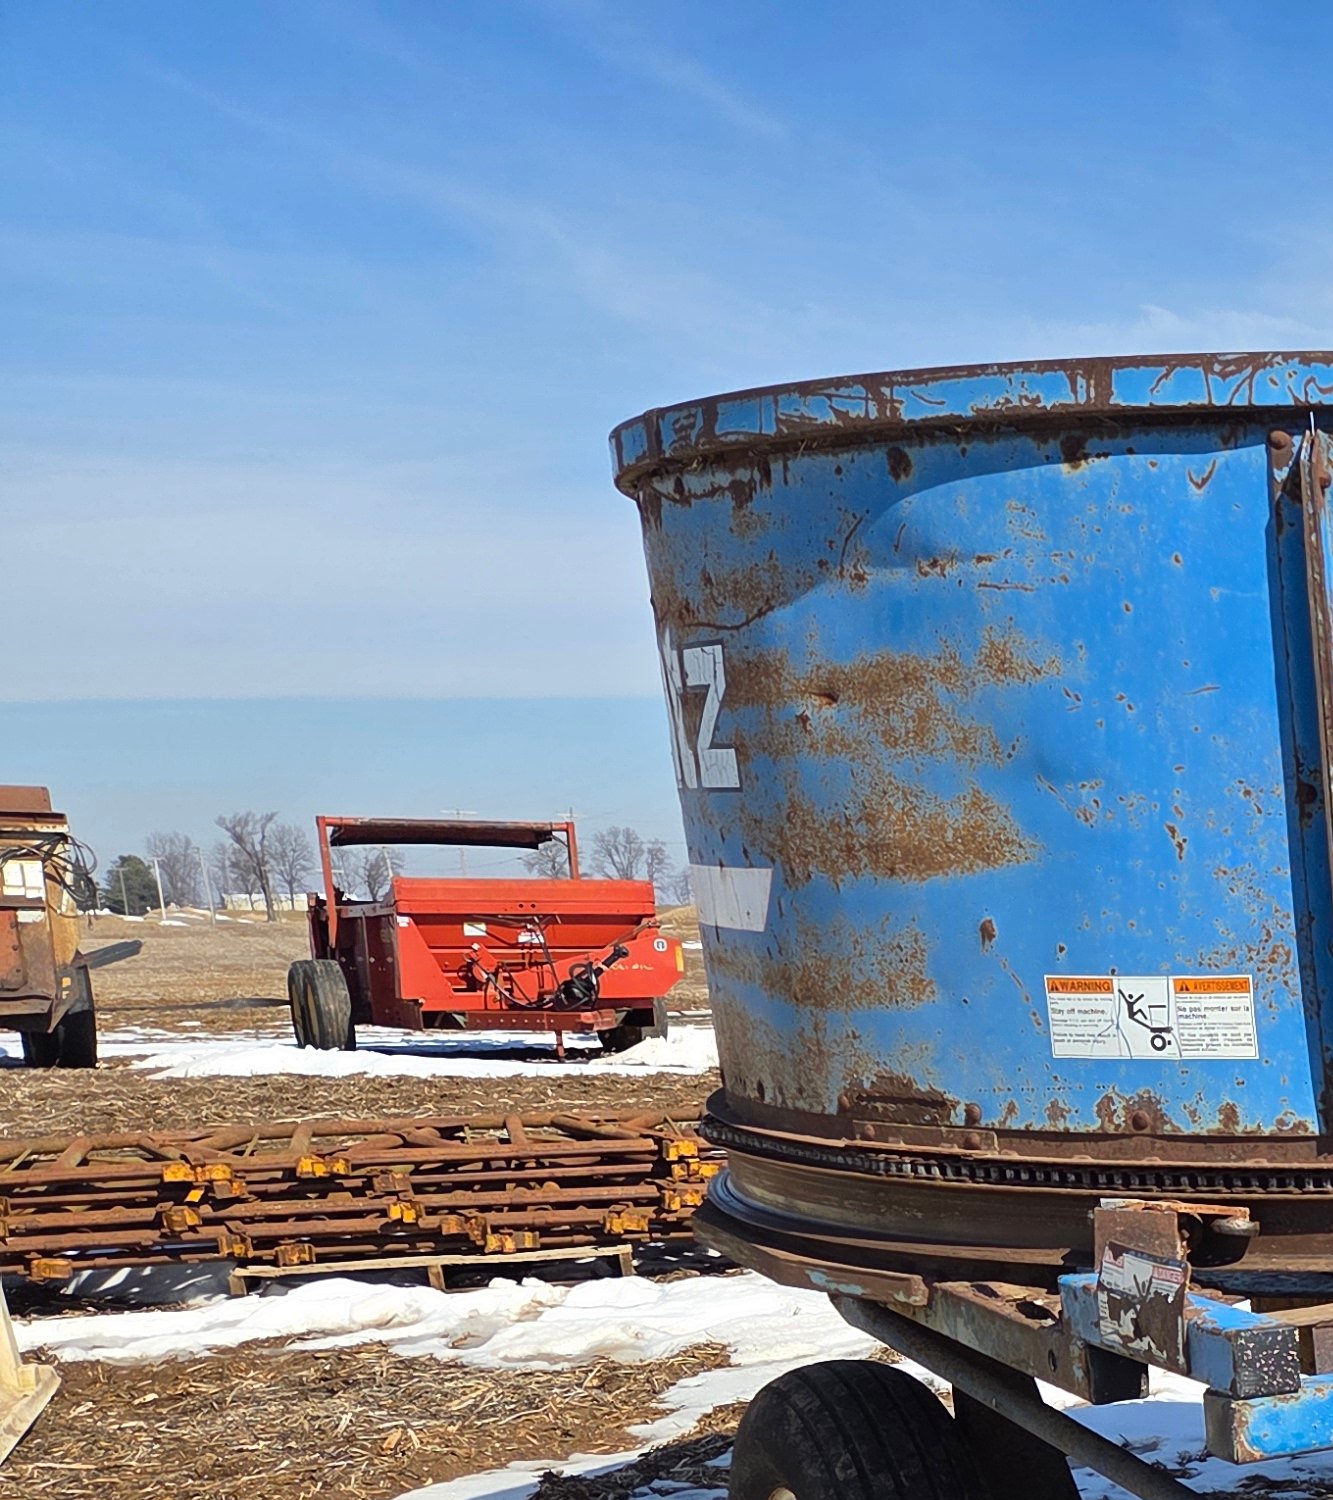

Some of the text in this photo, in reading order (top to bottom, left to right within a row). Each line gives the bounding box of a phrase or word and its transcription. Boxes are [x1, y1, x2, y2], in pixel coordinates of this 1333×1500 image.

[1058, 980, 1111, 992] WARNING
[1193, 979, 1248, 992] AVERTISSEMENT
[1050, 1007, 1064, 1015] Stay
